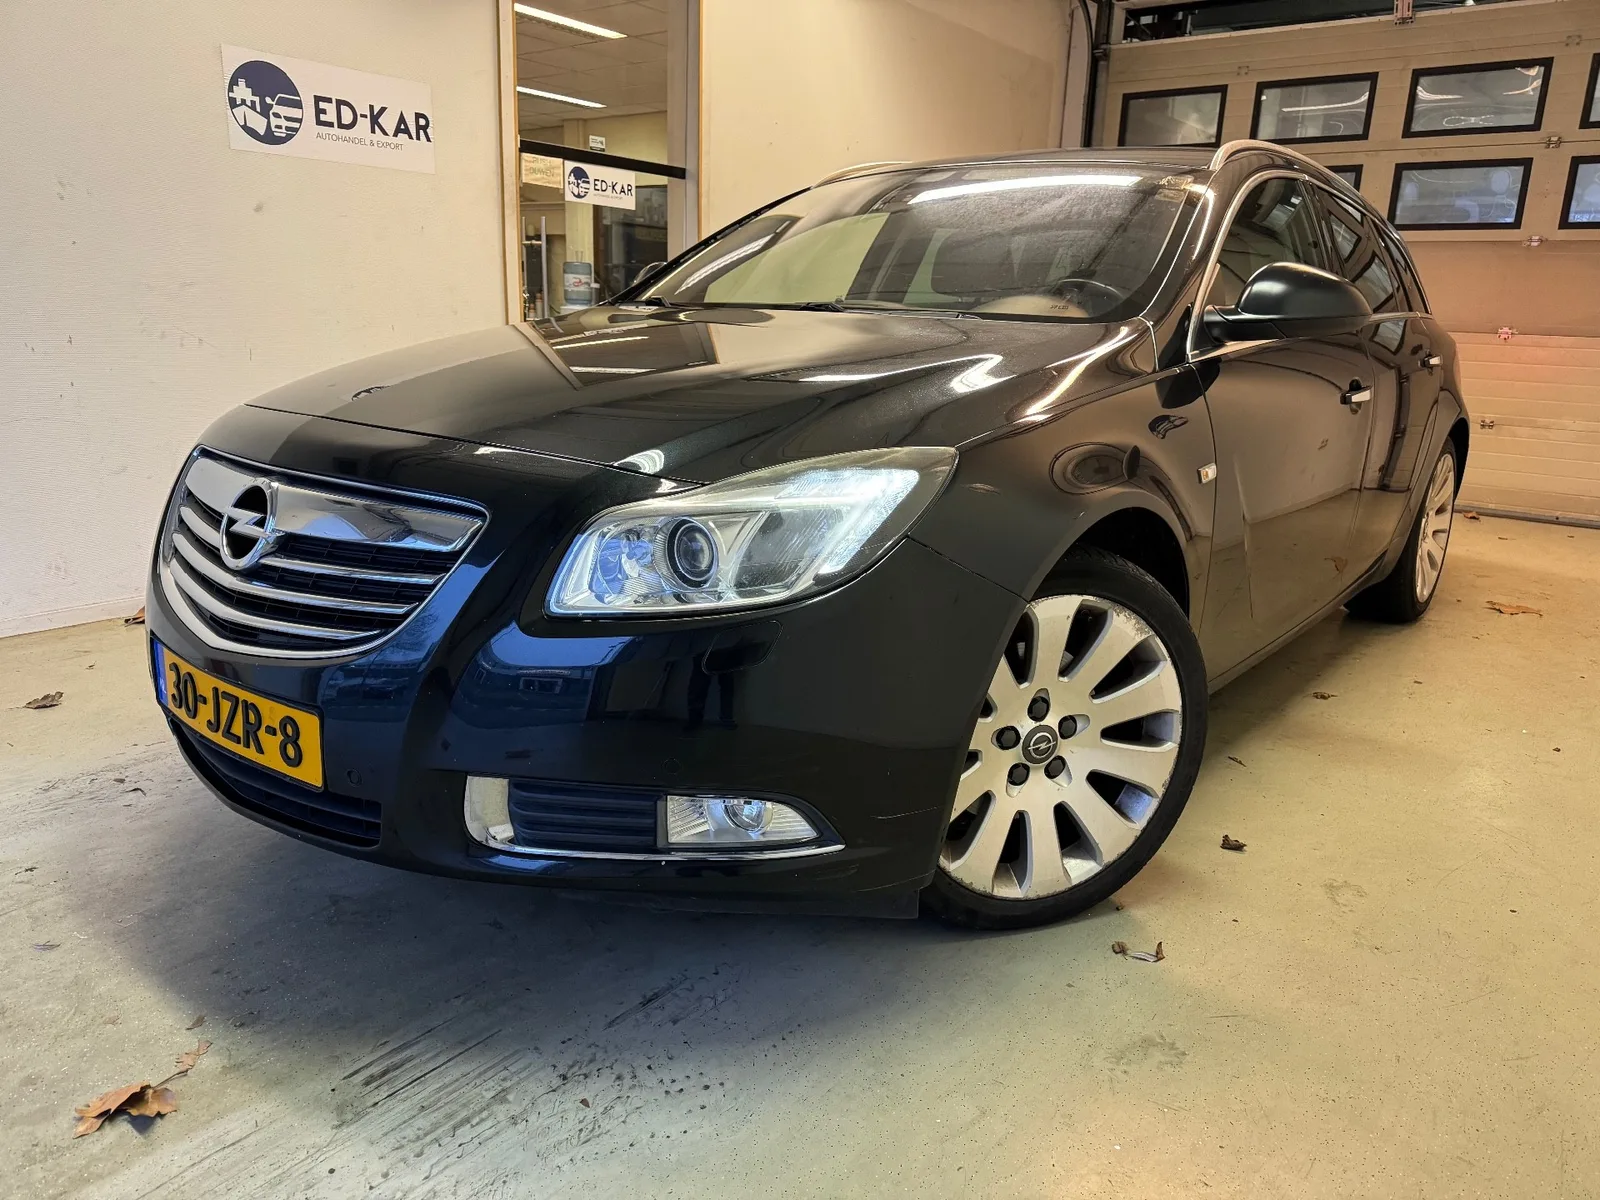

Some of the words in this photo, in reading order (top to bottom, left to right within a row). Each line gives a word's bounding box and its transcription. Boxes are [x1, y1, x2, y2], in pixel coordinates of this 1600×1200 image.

[313, 95, 432, 143] ED-KAR
[316, 131, 368, 147] AUTOHANDEL
[369, 139, 375, 147] &
[377, 140, 404, 151] EXPORT
[593, 178, 633, 197] ED-KAR
[169, 662, 303, 768] 30-JZR-8
